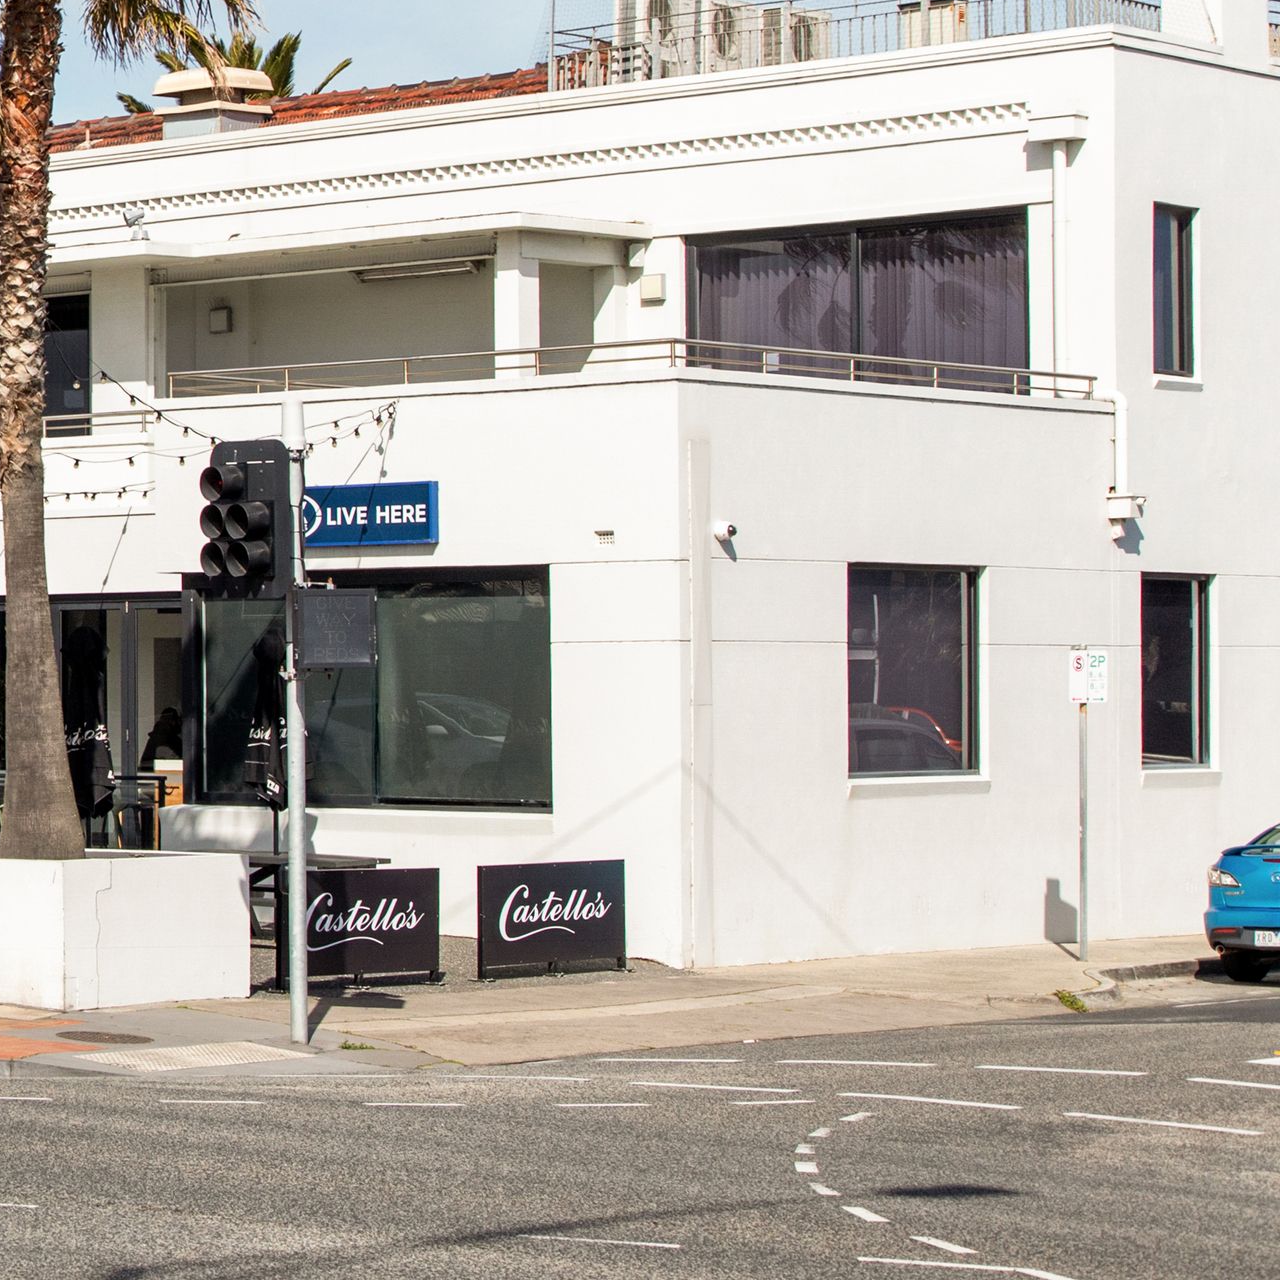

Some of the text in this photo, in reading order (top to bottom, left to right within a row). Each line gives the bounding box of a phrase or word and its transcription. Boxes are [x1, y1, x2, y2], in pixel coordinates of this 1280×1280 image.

[326, 506, 368, 526] LIVE
[376, 504, 427, 524] HERE
[1090, 655, 1106, 668] 2P
[307, 892, 425, 951] Castello's
[499, 884, 613, 942] Castello's
